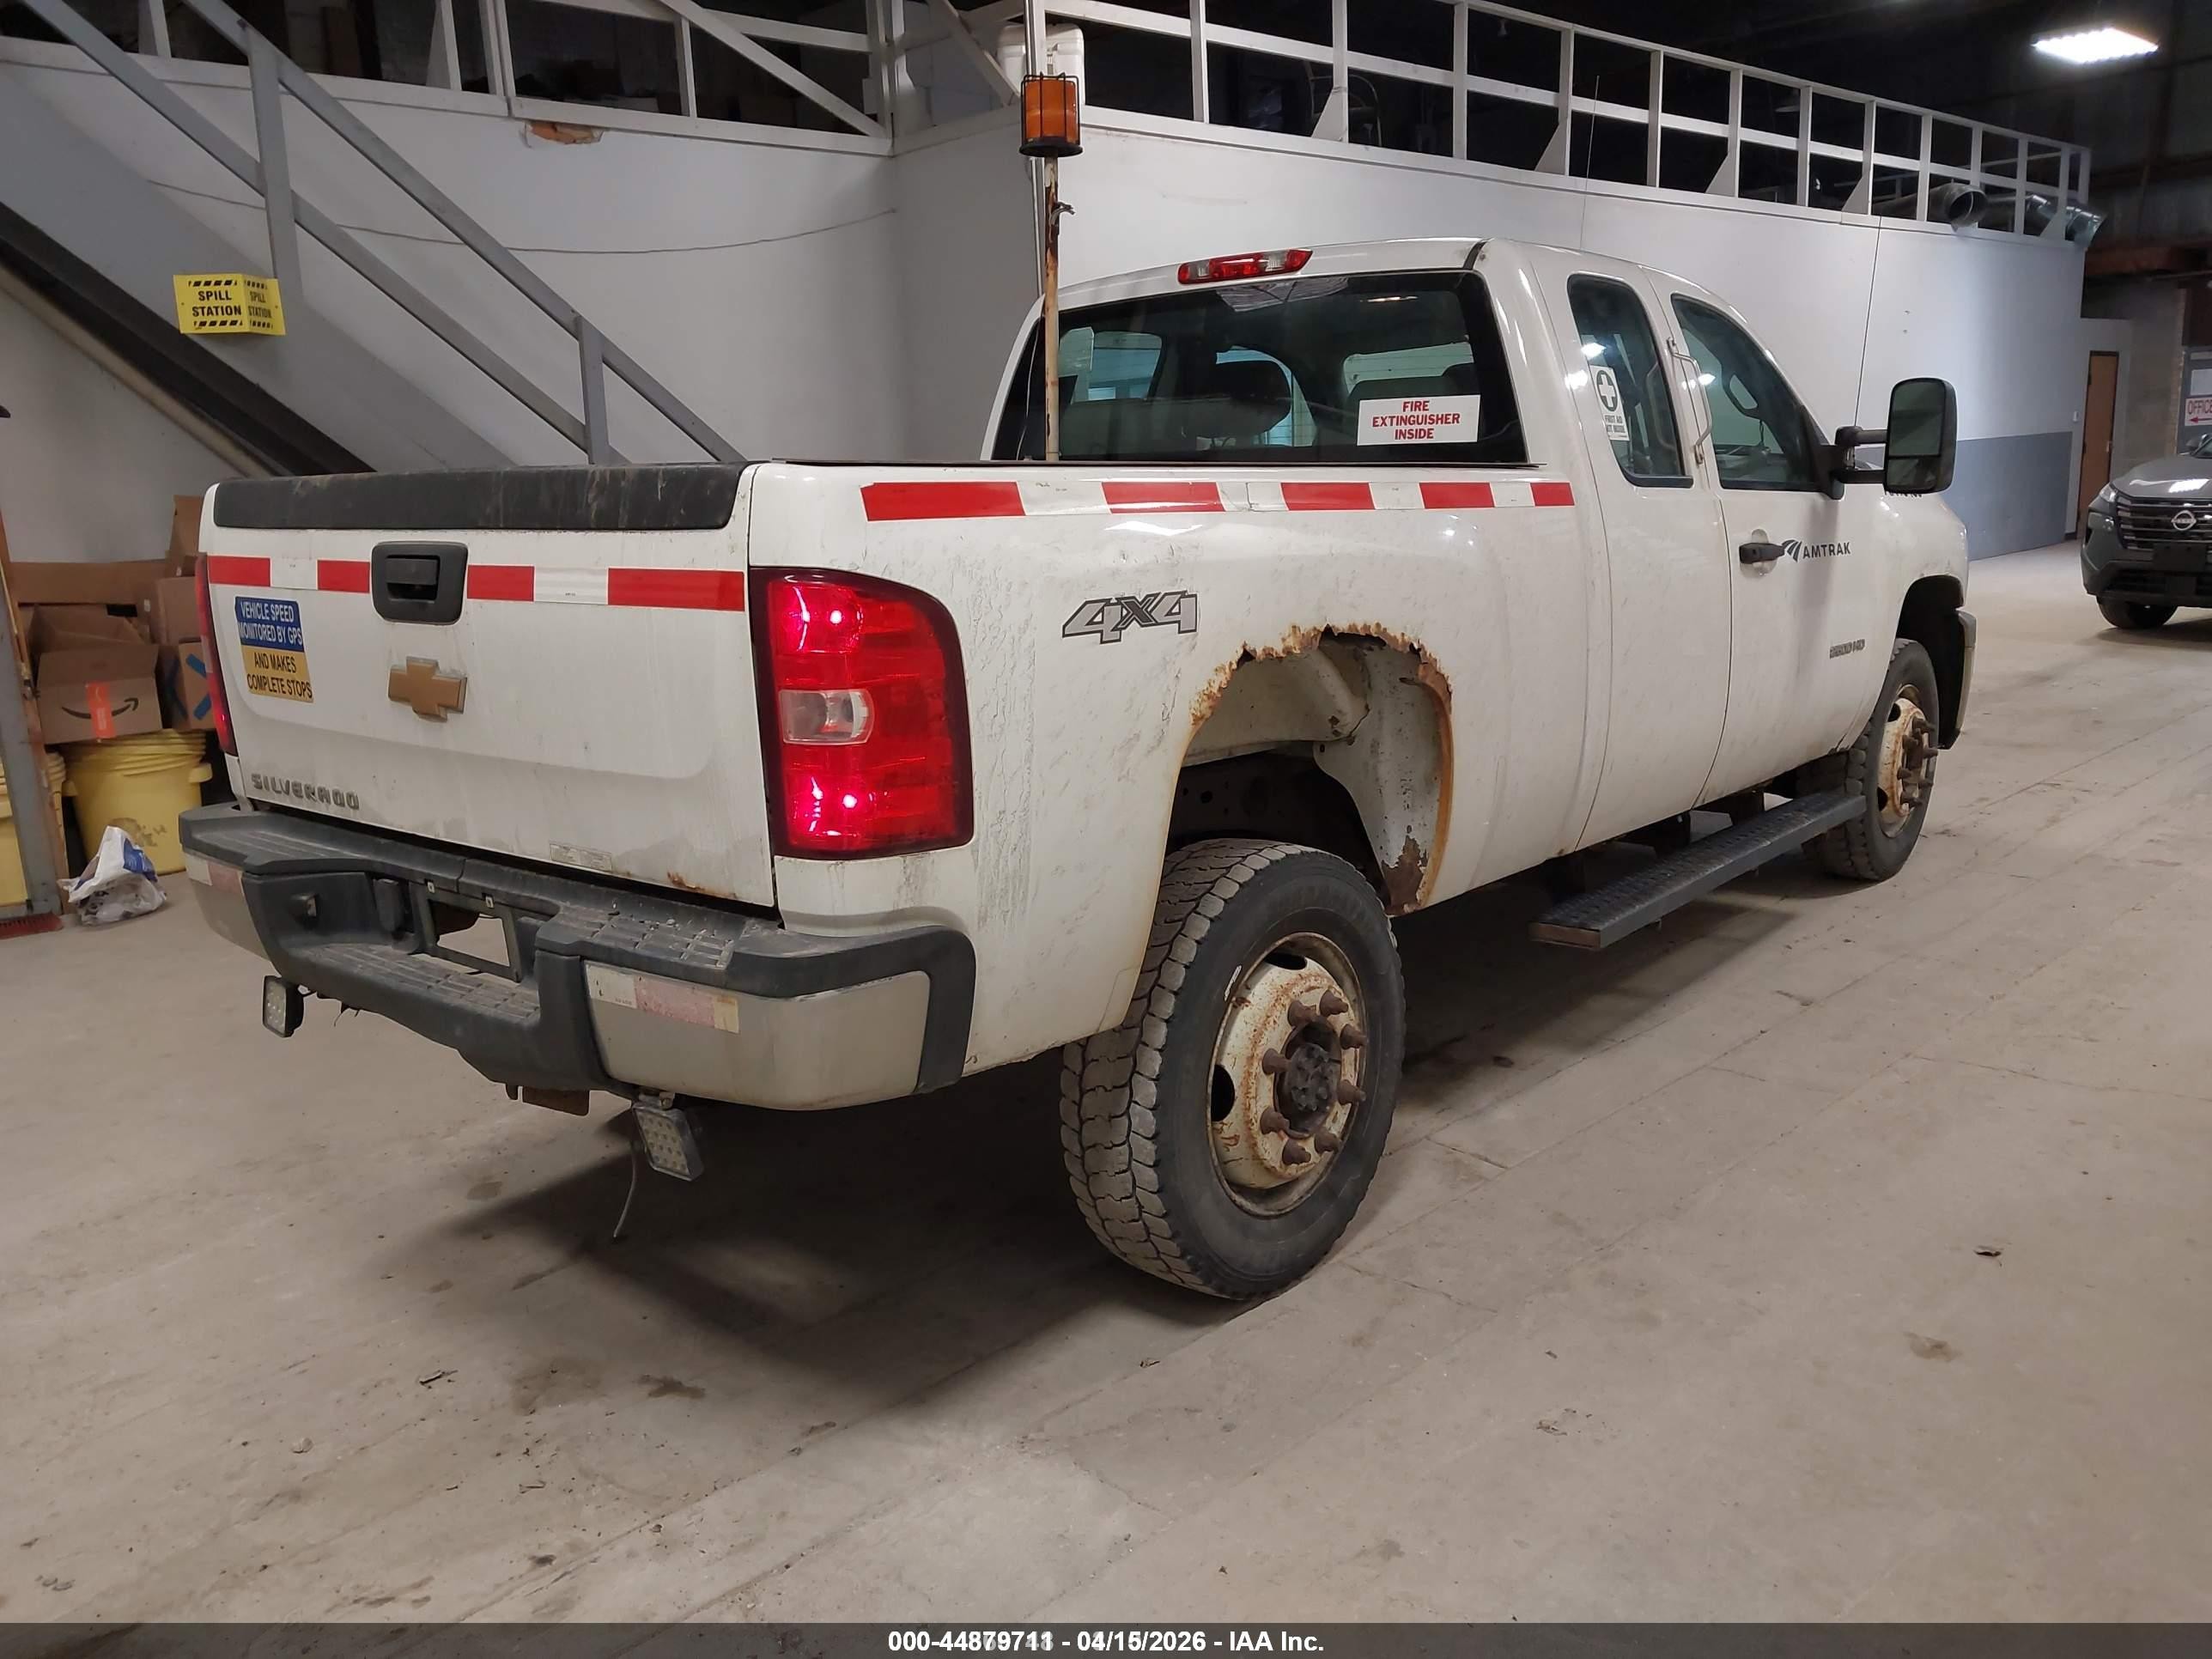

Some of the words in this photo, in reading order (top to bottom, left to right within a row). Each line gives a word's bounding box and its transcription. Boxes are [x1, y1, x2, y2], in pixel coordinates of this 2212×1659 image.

[198, 290, 232, 301] SPILL
[249, 291, 266, 303] SPILL
[191, 305, 242, 317] STATION
[247, 306, 272, 319] STATION
[1402, 400, 1431, 412] FIRE
[1372, 413, 1461, 428] EXTINGUISHER
[1395, 428, 1435, 441] INSIDE
[1802, 542, 1851, 560] AMTRAK
[240, 601, 270, 621] VEHICLE
[270, 604, 295, 623] SPEED
[239, 621, 276, 642] MONITORED
[276, 625, 288, 643] BY
[288, 627, 303, 646] GPS
[254, 653, 270, 669] AND
[270, 654, 297, 673] MAKES
[246, 673, 287, 695] COMPLETE
[287, 678, 313, 699] STOPS
[252, 773, 360, 810] SILVERADO
